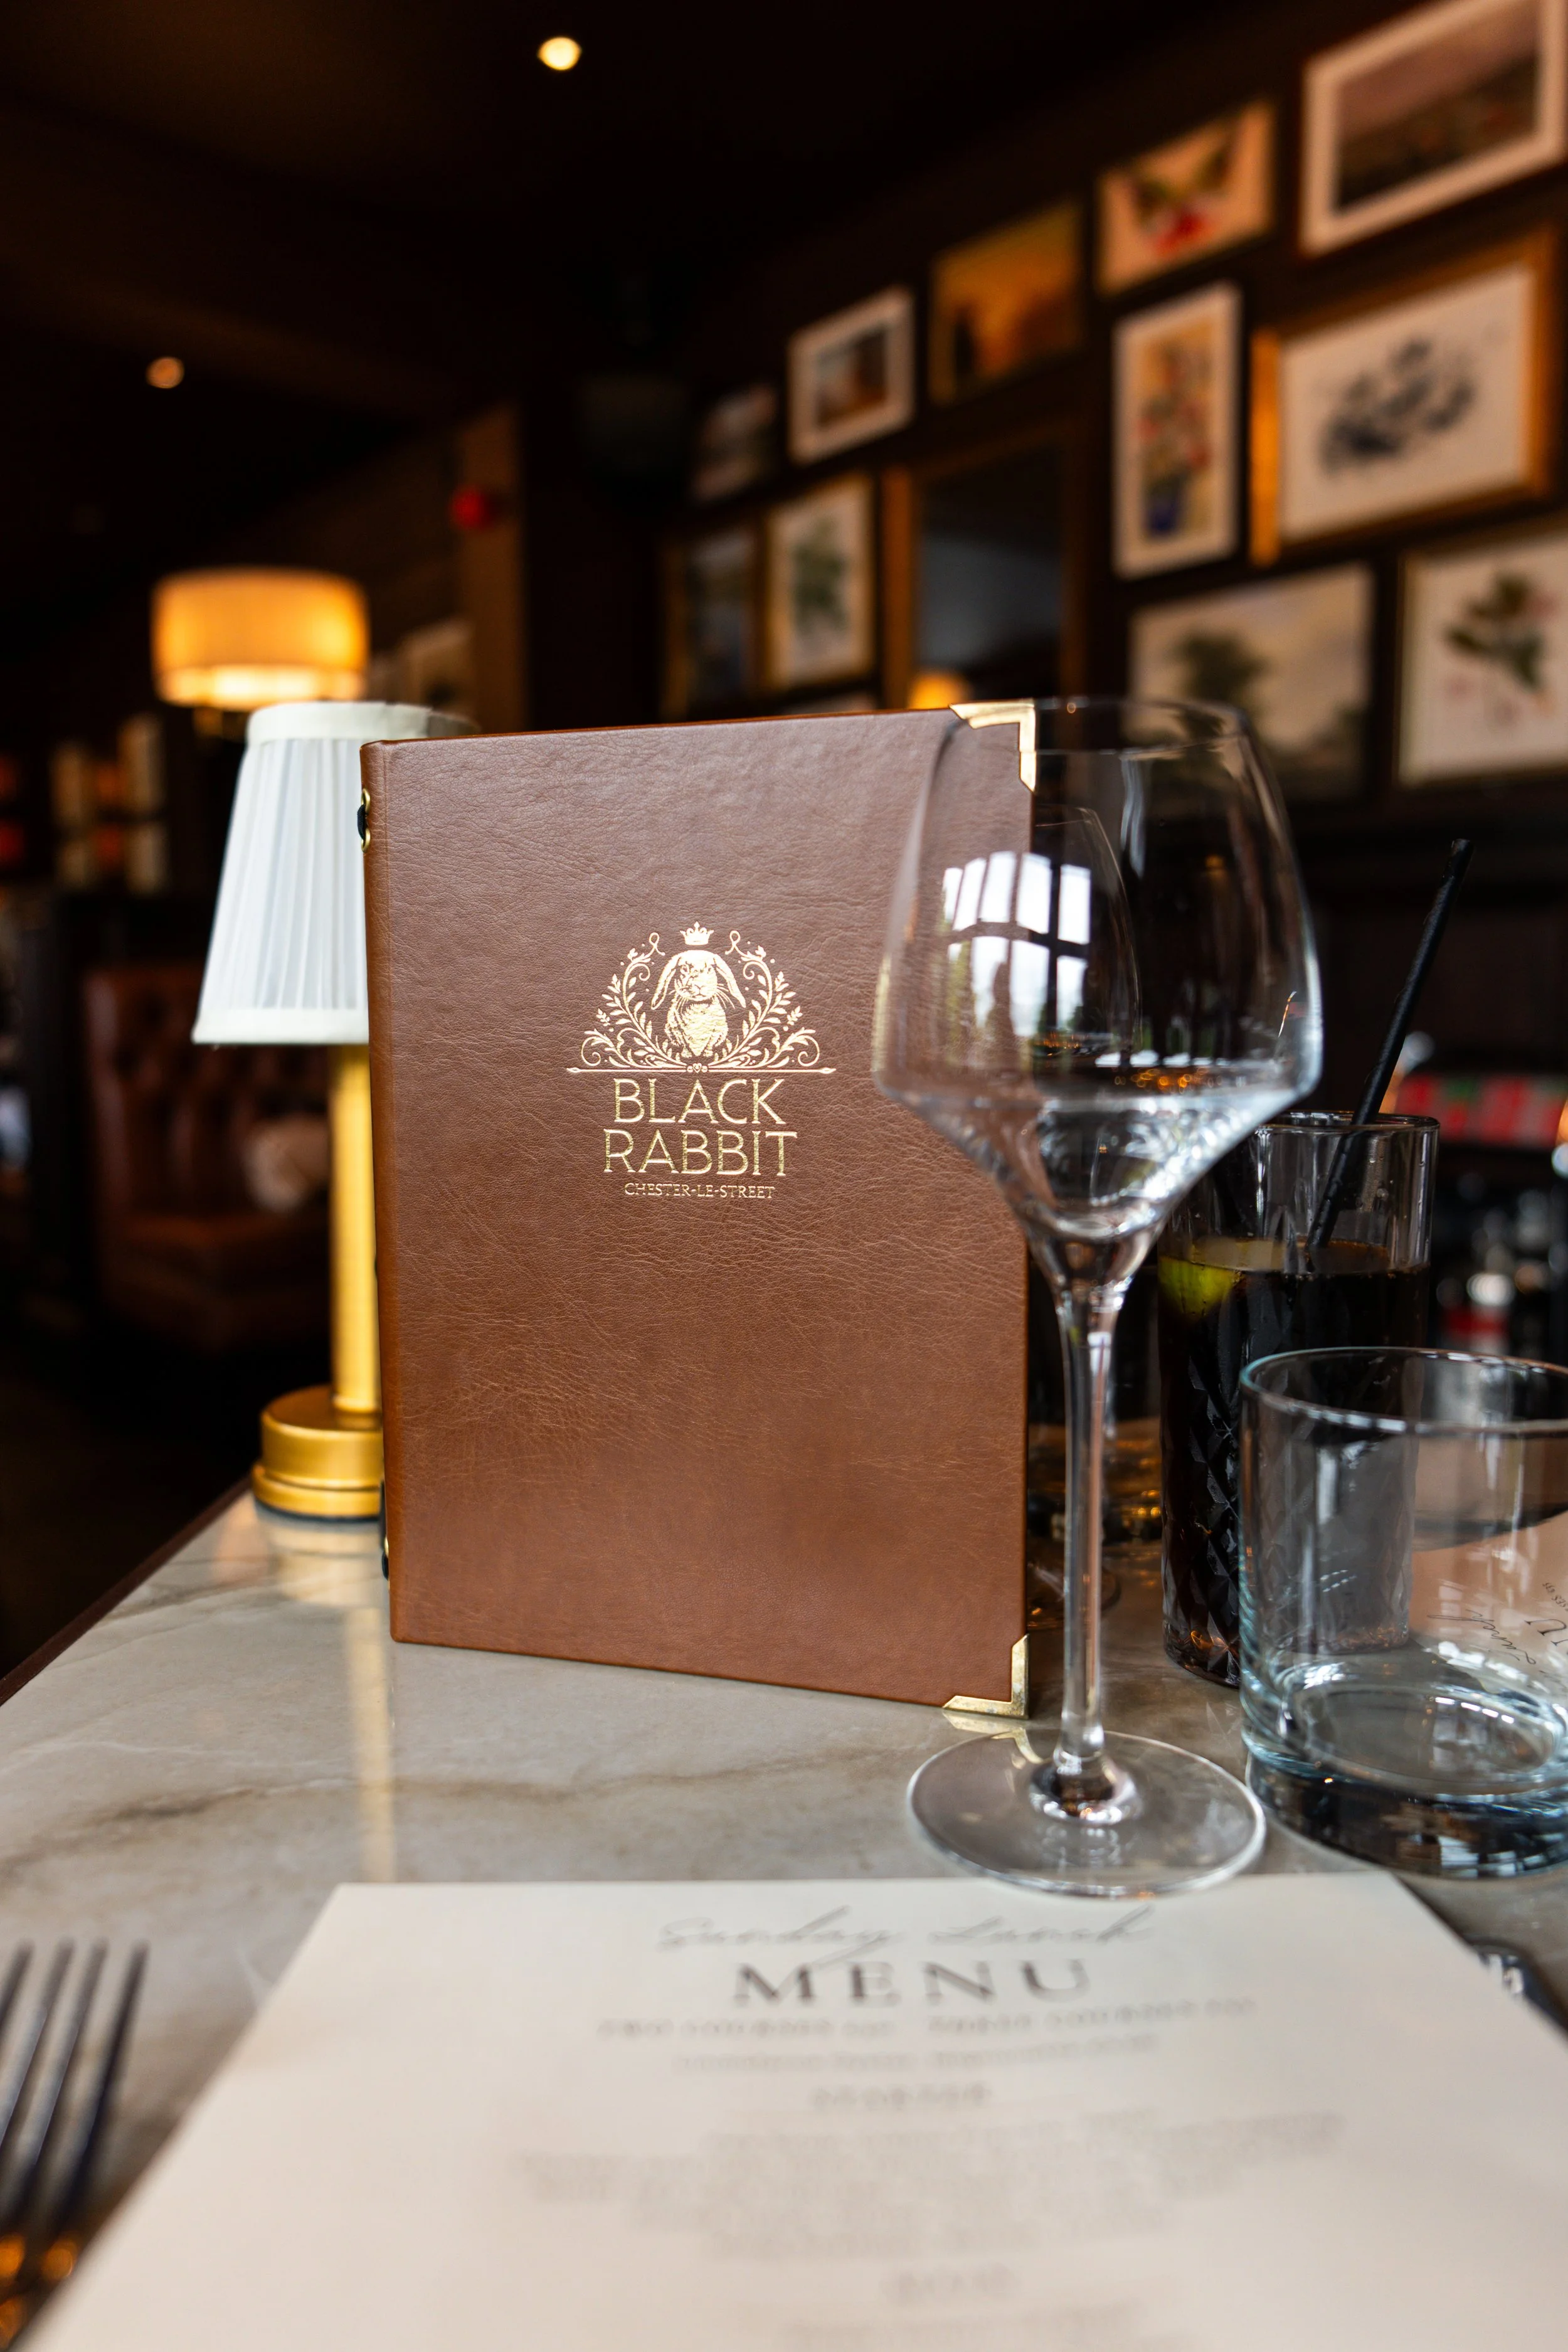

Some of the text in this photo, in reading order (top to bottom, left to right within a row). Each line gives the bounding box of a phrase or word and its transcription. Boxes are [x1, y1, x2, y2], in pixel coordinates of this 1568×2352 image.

[613, 1078, 787, 1125] BLACK
[603, 1128, 798, 1177] RABBIT
[624, 1182, 776, 1199] CHESTER-LE-STREET
[657, 1903, 1155, 1970] Sunday Lunch
[733, 1958, 1091, 2008] MENU
